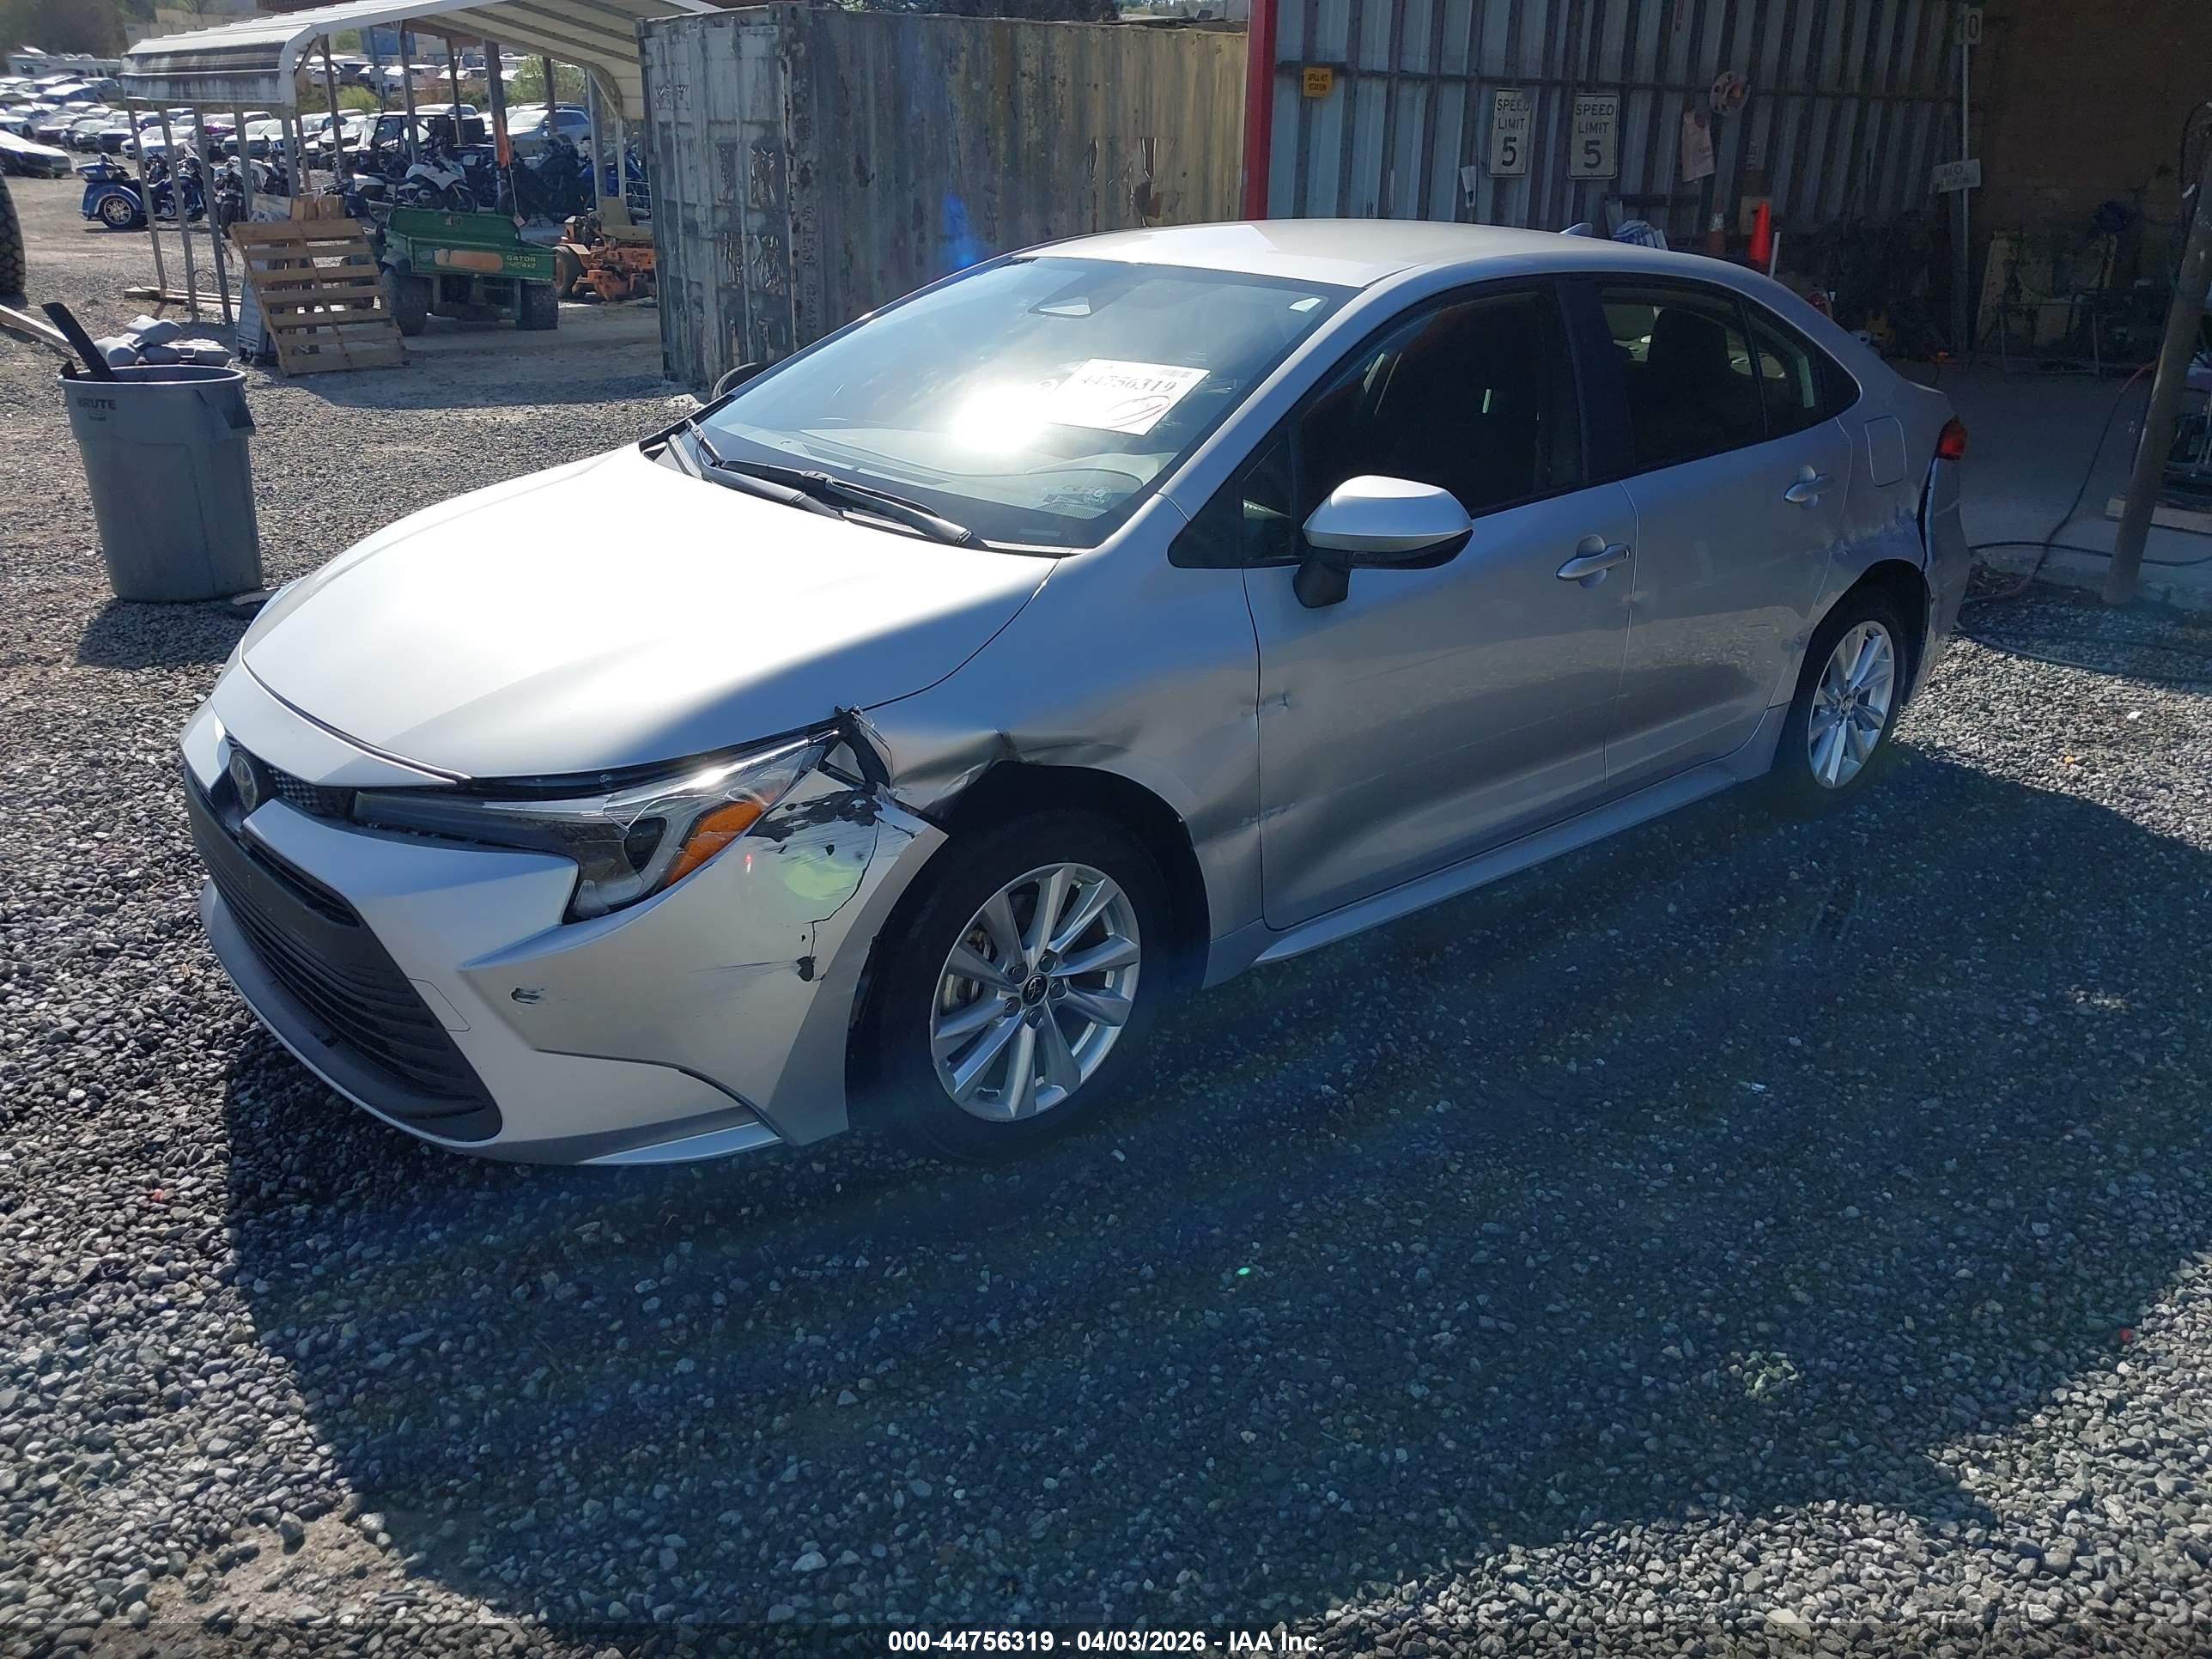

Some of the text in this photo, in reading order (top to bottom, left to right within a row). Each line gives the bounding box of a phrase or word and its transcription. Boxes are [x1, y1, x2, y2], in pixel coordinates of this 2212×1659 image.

[1497, 99, 1530, 112] SPEED
[1575, 103, 1615, 116] SPEED
[1498, 118, 1526, 130] LIMIT
[1577, 121, 1610, 134] LIMIT
[1501, 136, 1517, 167] 5
[1583, 139, 1601, 169] 5
[506, 254, 537, 263] GATOR
[76, 396, 118, 410] BRUTE
